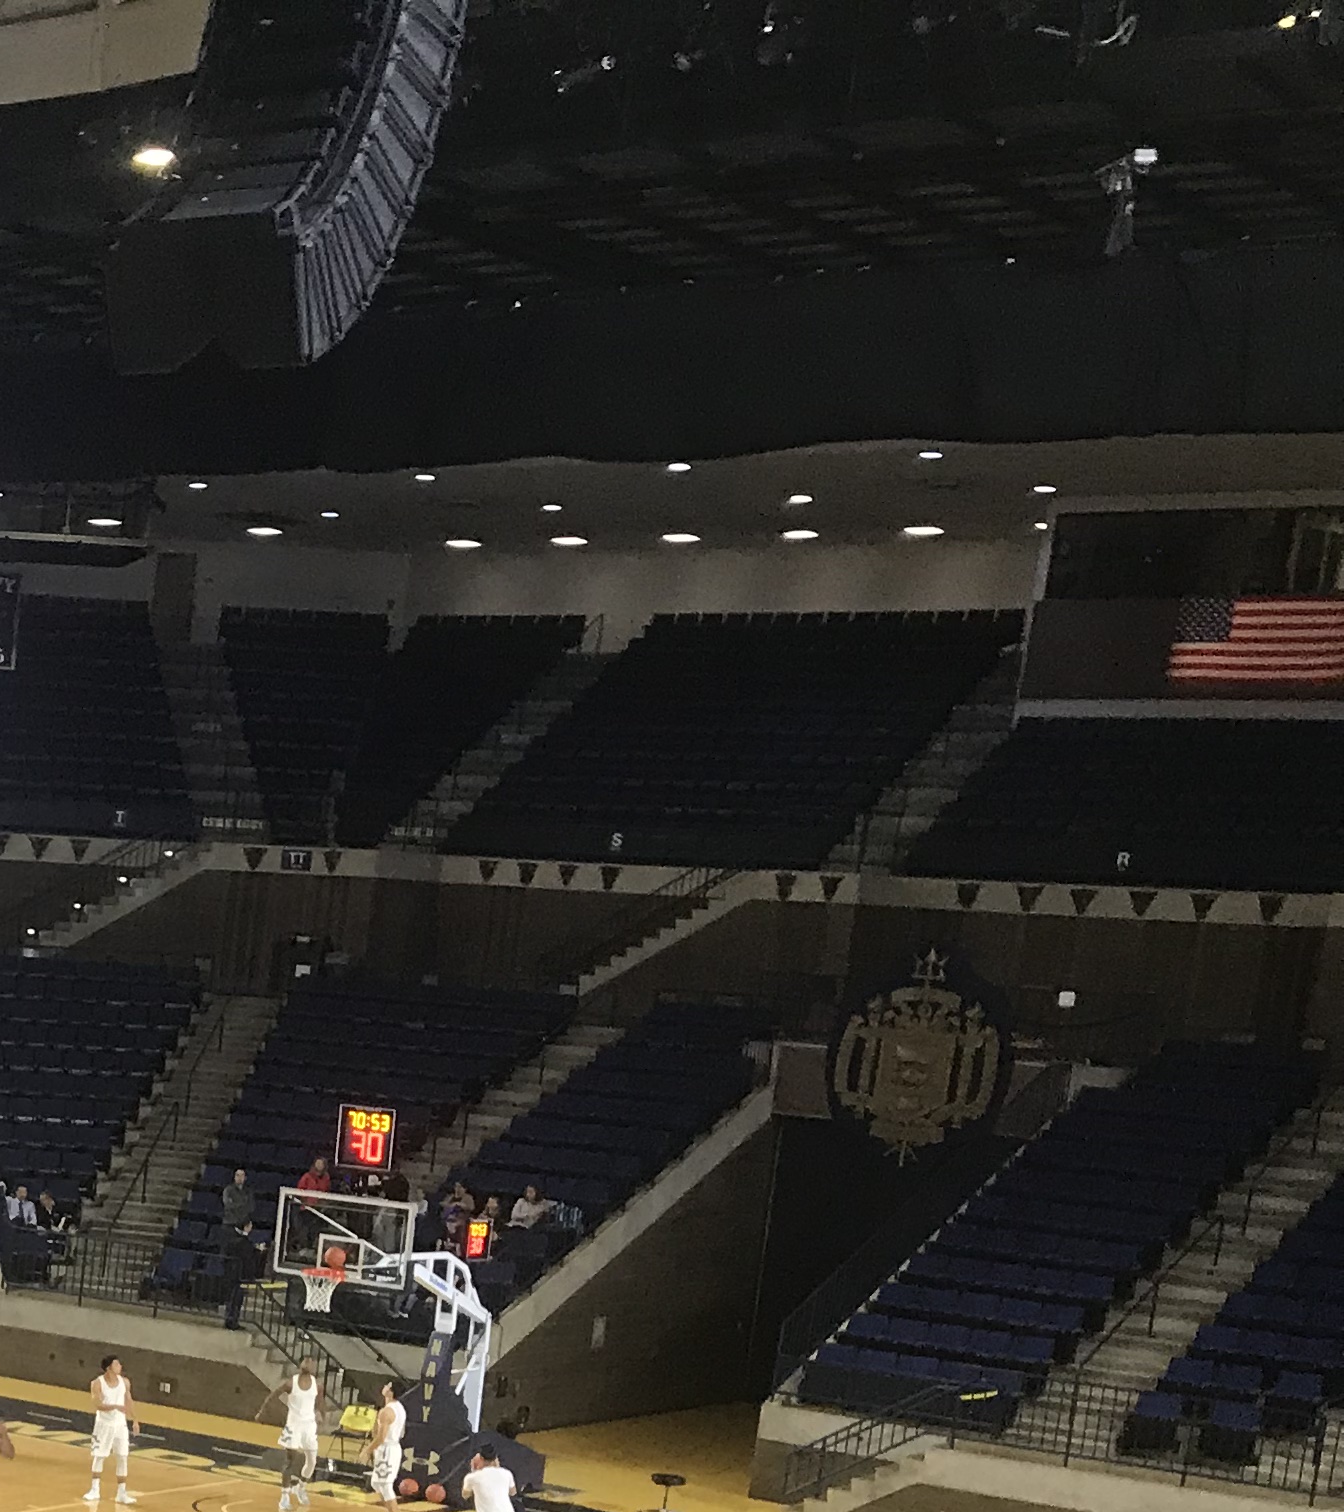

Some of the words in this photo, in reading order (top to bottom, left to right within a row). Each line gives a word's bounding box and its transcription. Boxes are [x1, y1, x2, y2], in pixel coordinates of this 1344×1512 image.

[612, 832, 623, 847] S
[349, 1110, 391, 1133] 70:53
[422, 1339, 442, 1423] NAVY
